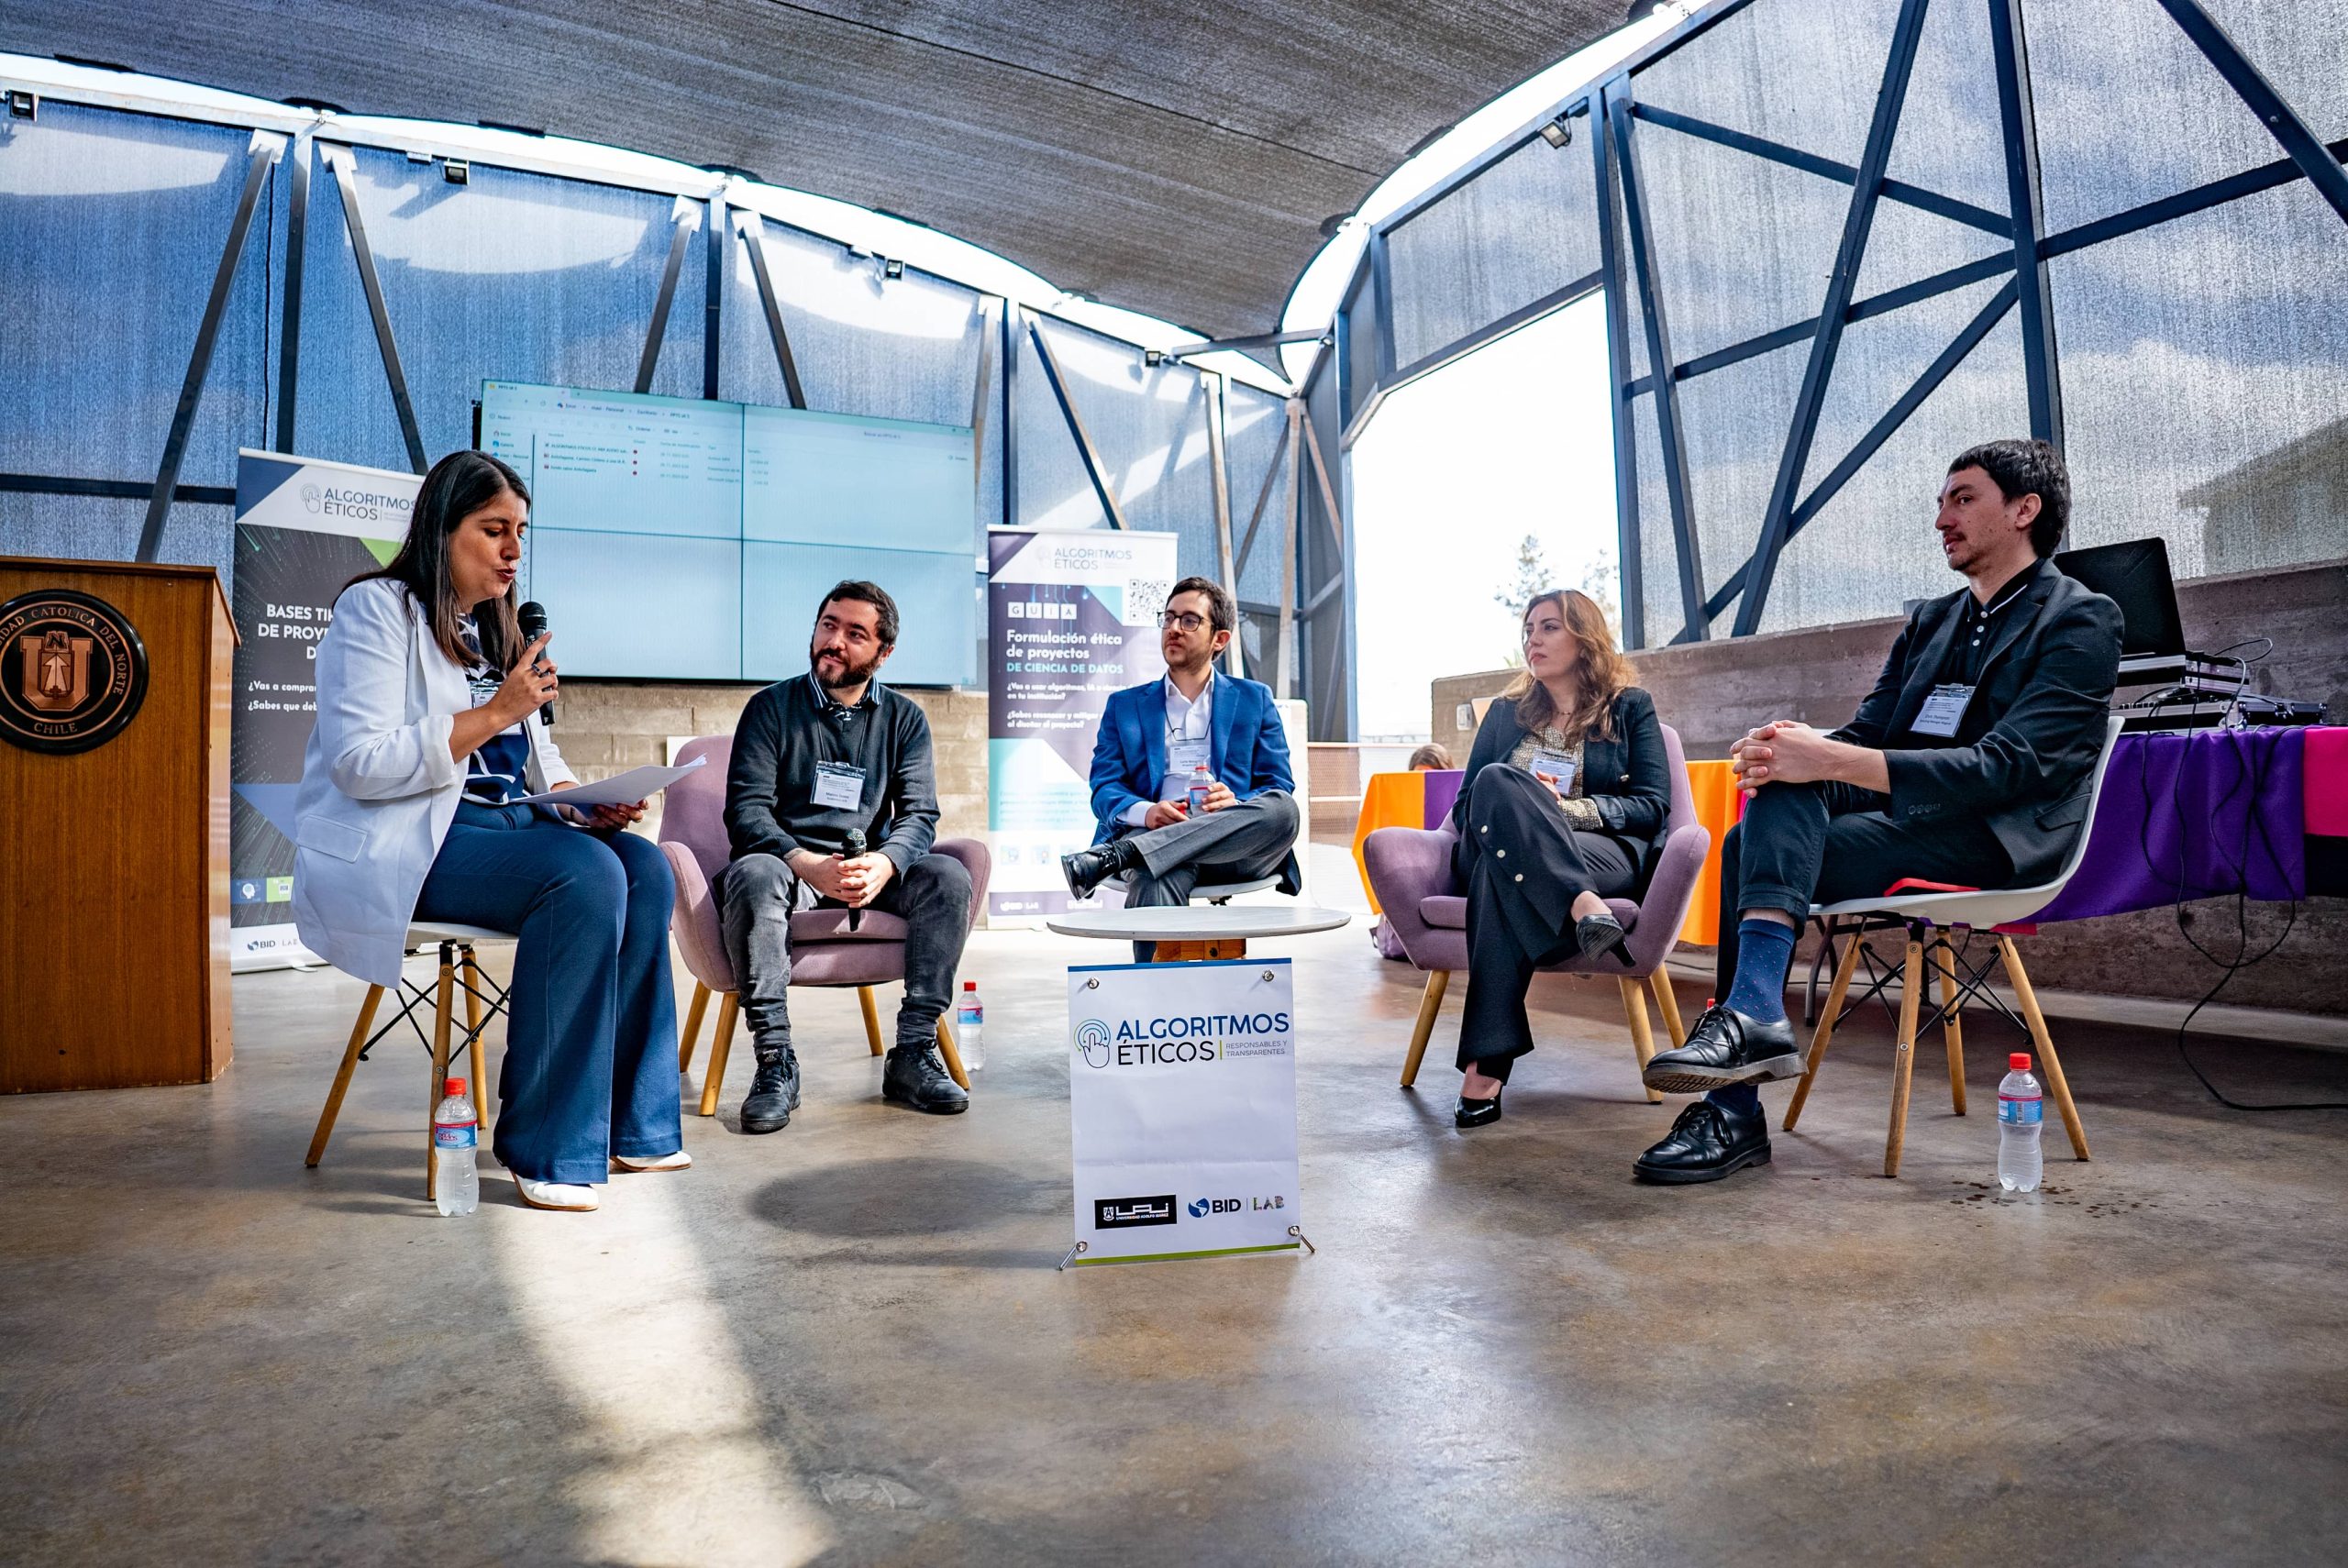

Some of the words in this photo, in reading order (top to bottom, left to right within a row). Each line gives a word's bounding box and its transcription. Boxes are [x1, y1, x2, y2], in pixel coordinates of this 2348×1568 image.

[324, 499, 378, 521] ÉTICOS
[1054, 547, 1133, 561] ALGORITMOS
[266, 603, 312, 620] BASES
[258, 623, 280, 638] DE
[1006, 630, 1086, 645] Formulación
[1091, 633, 1123, 646] ética
[31, 607, 95, 627] CATOLICA
[99, 625, 116, 649] DEL
[113, 653, 128, 696] NORTE
[1006, 646, 1024, 657] de
[1027, 648, 1090, 661] proyectos
[1006, 662, 1022, 672] DE
[1024, 662, 1069, 673] CIENCIA
[1071, 663, 1086, 673] DE
[1089, 664, 1124, 674] DATOS
[248, 680, 271, 691] ¿Vas
[1018, 692, 1026, 701] tu
[248, 700, 281, 712] ¿Sabes
[282, 702, 300, 712] que
[34, 723, 78, 734] CHILE
[260, 940, 276, 948] BID
[1116, 1012, 1290, 1041] ALGORITMOS
[1225, 1041, 1281, 1049] RESPONSABLES
[1118, 1039, 1215, 1066] ÉTICOS
[1225, 1048, 1285, 1057] TRANSPARENTES
[1212, 1198, 1241, 1214] BID
[1253, 1196, 1285, 1211] LAB
